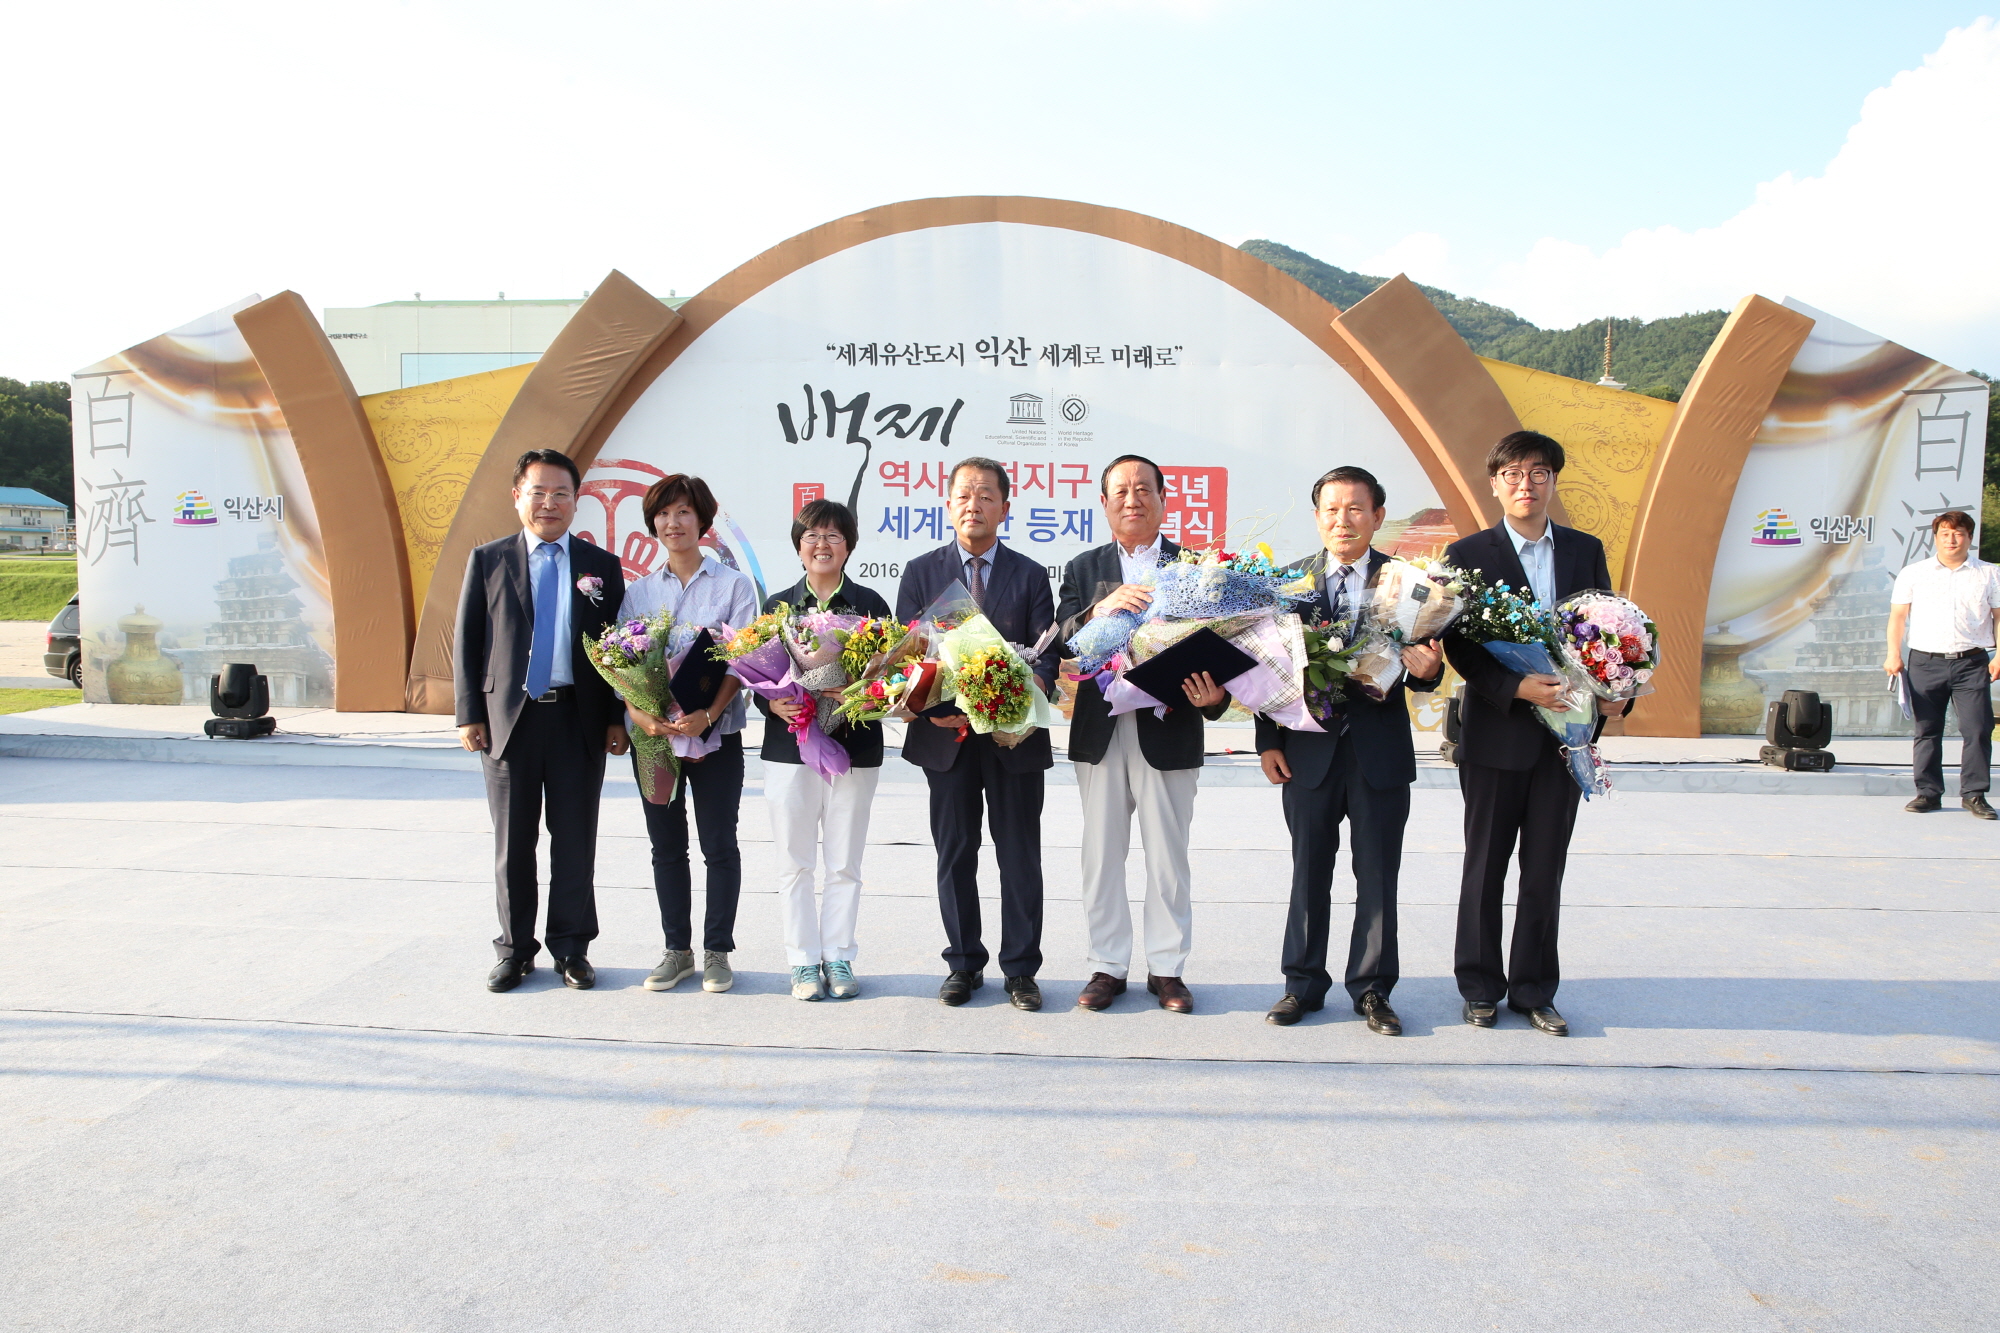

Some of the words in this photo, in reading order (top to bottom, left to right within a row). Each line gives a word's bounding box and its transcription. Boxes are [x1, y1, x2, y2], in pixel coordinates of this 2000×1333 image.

[975, 336, 1032, 367] 익산
[1039, 344, 1105, 368] 세계로
[1111, 345, 1183, 369] 미래로”
[1011, 401, 1042, 418] UNESCO
[73, 368, 156, 566] 百濟
[879, 461, 1093, 499] 역사지구
[223, 496, 283, 521] 익산시
[1026, 507, 1093, 543] 등재
[1809, 516, 1874, 543] 익산시
